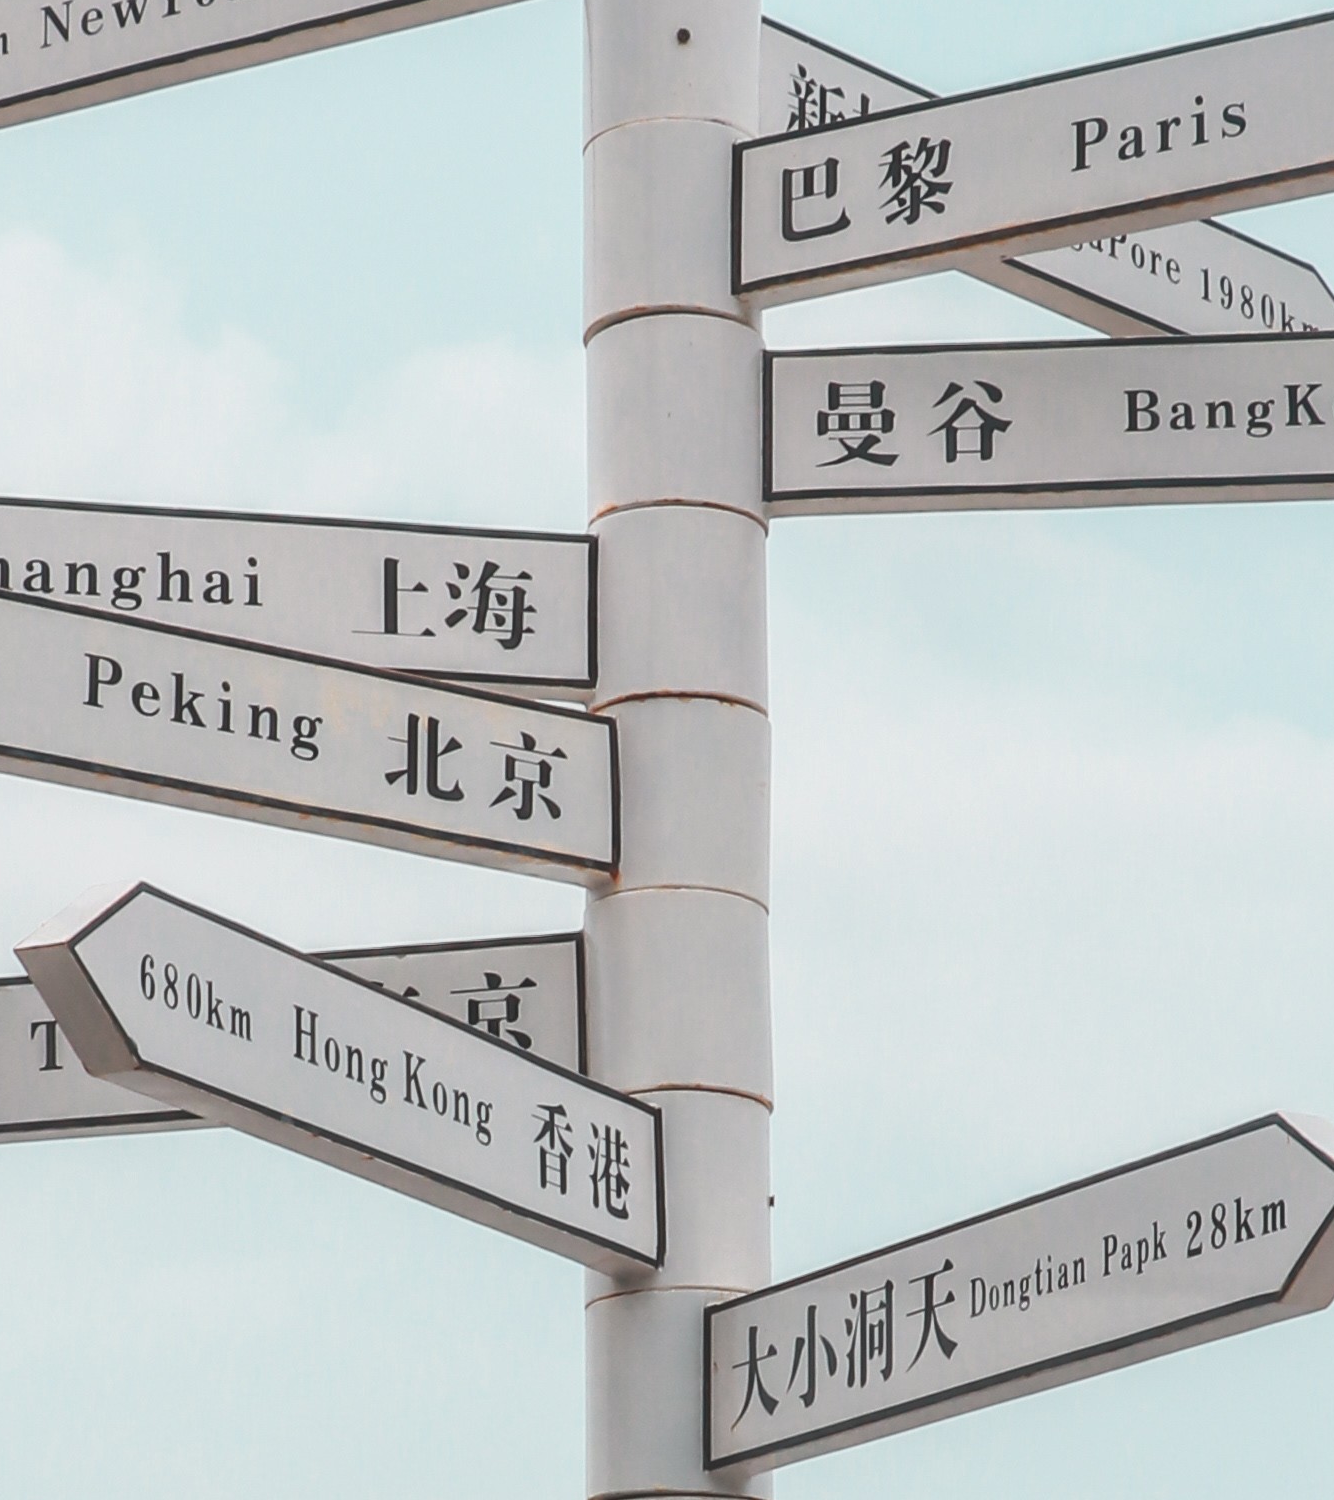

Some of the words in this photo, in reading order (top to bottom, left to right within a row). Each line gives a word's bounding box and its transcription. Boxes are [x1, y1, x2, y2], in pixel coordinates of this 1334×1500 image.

[782, 137, 953, 242] 巴黎
[1071, 96, 1246, 172] Paris
[817, 380, 1012, 467] 曼谷
[353, 558, 537, 650] 上海
[83, 653, 323, 761] Peking
[385, 713, 567, 820] 北京
[141, 954, 251, 1041] 680km
[532, 1105, 630, 1220] 香港
[731, 1259, 958, 1431] 大小洞天
[970, 1255, 1085, 1318] Dongtian
[1103, 1222, 1167, 1276] Papk
[1187, 1197, 1286, 1258] 28km
